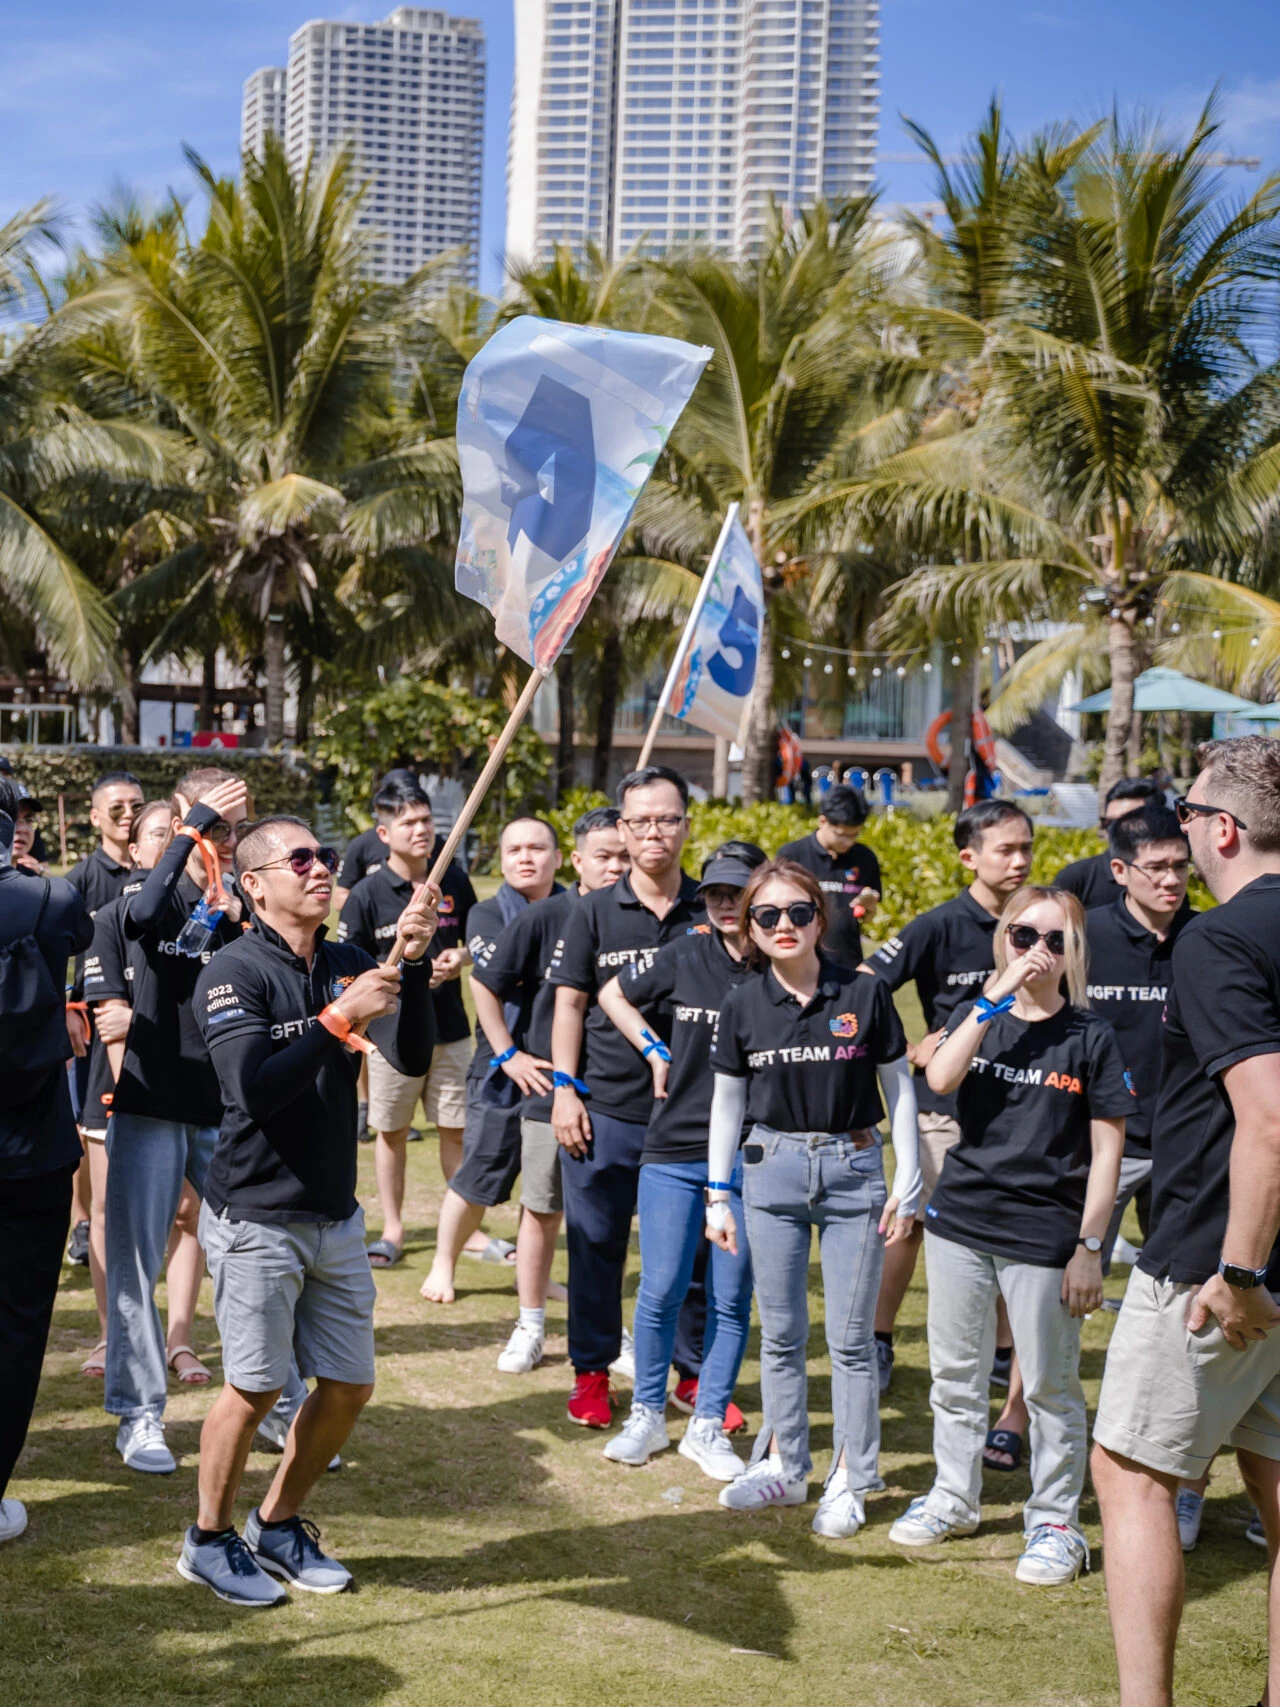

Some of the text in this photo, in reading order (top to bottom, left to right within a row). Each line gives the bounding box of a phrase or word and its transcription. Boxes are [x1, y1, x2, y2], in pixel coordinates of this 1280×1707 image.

[598, 949, 638, 968] #GFT
[206, 983, 234, 1000] 2023
[1086, 985, 1125, 1001] #GFT
[206, 995, 240, 1013] edition
[778, 1045, 831, 1063] TEAM
[993, 1062, 1043, 1086] TEAM
[1044, 1070, 1083, 1096] APA
[992, 1432, 1009, 1447] C
